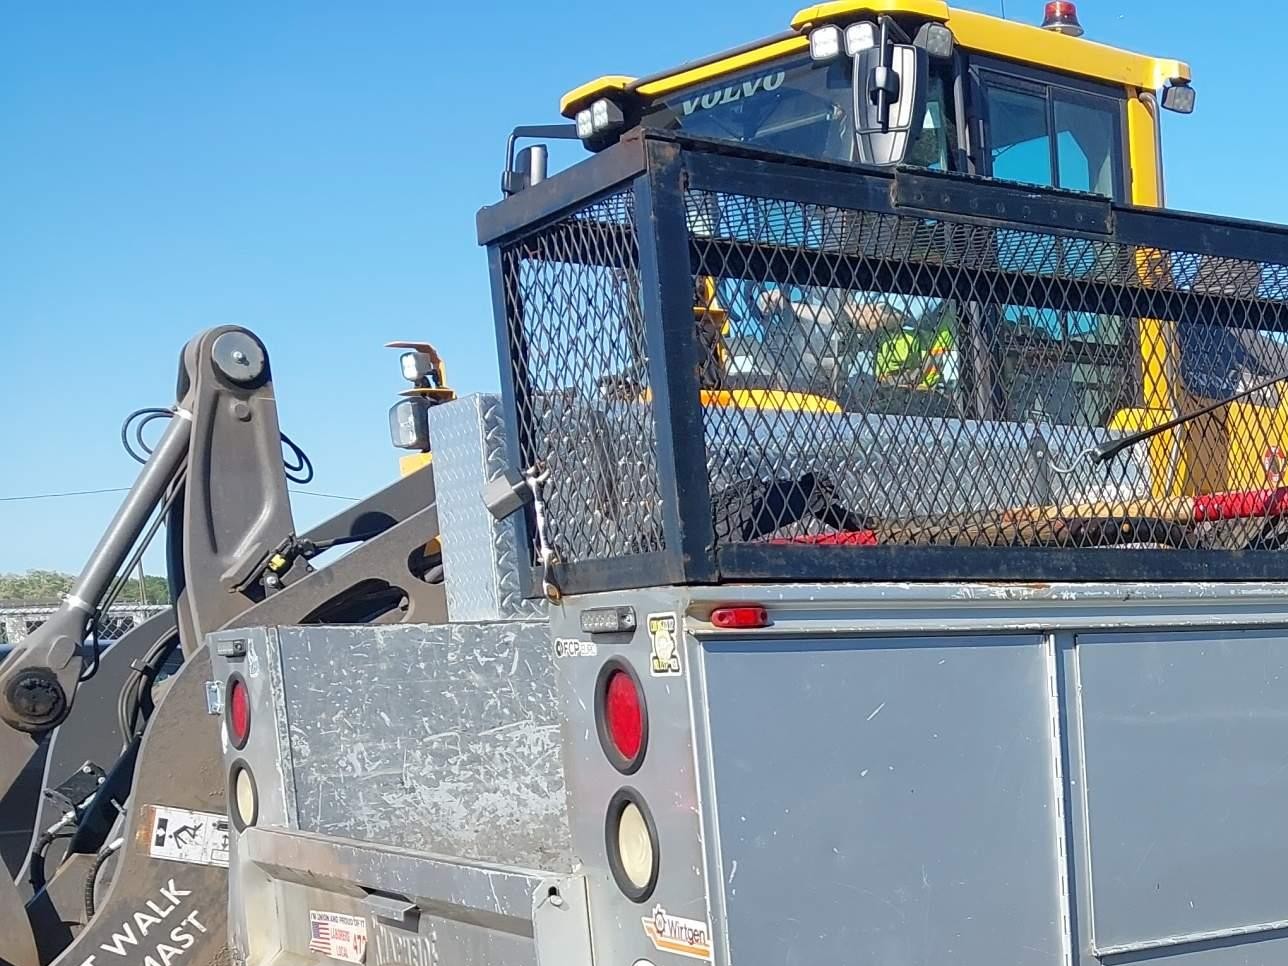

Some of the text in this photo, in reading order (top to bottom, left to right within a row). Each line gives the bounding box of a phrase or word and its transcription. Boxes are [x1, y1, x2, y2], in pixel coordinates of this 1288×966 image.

[682, 71, 785, 115] VOLVO
[563, 641, 580, 655] FCP
[100, 878, 192, 956] WALK
[667, 918, 706, 946] Wirtgen
